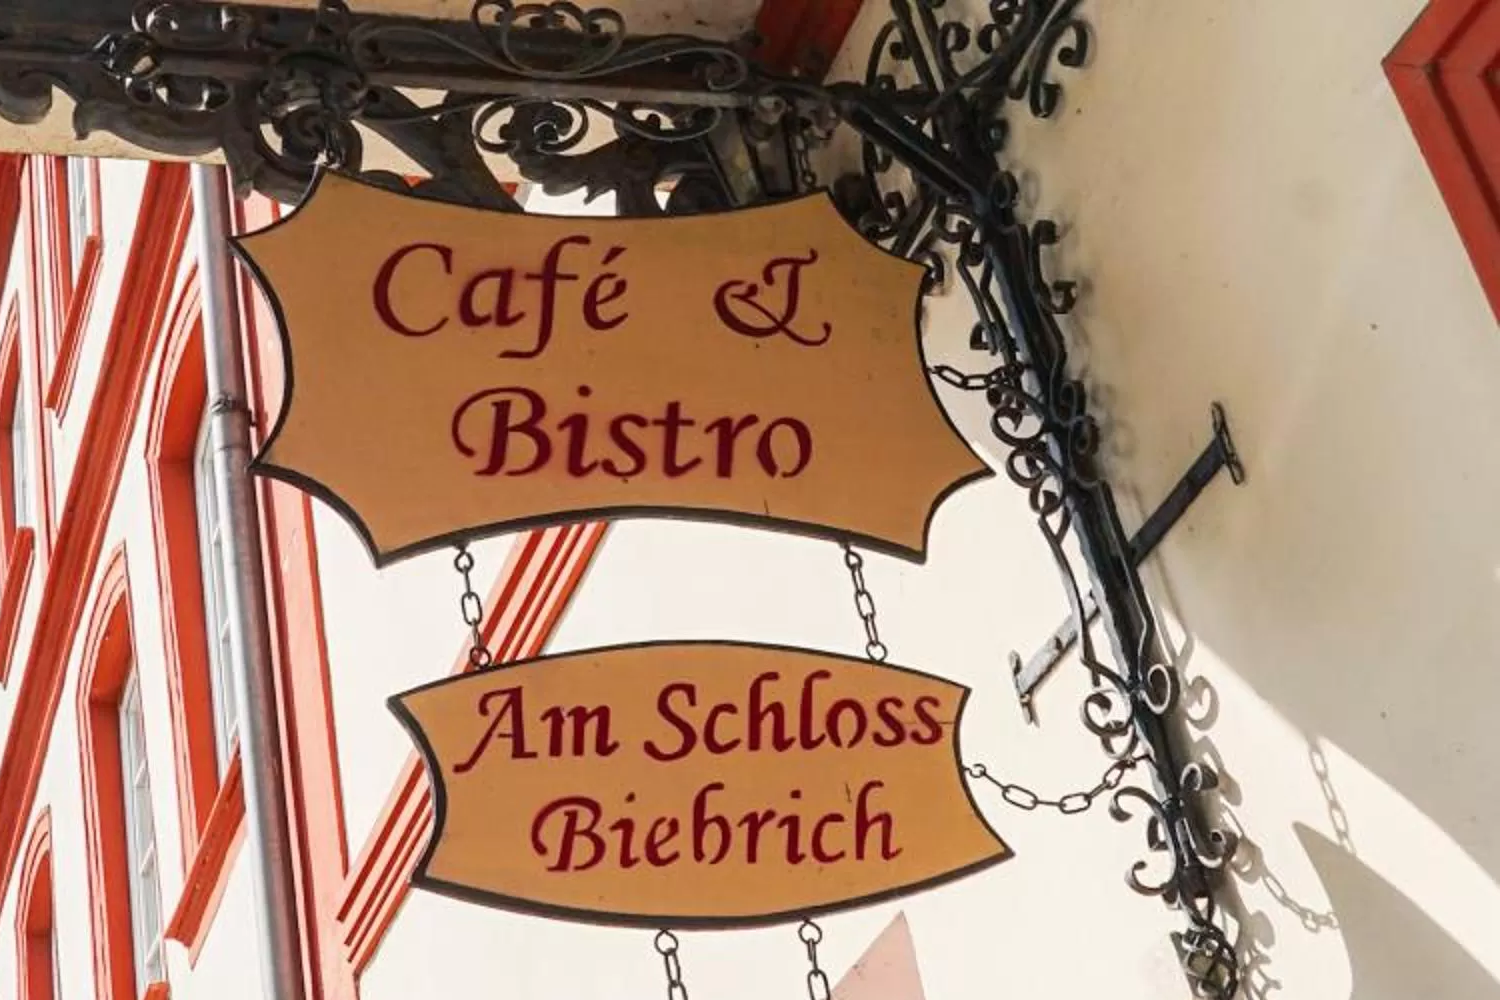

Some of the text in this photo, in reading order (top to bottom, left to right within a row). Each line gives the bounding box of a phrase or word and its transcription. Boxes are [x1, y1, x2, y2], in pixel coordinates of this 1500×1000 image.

[372, 234, 630, 360] Café
[450, 384, 813, 483] Bistro
[453, 669, 944, 774] Am Schloss
[530, 780, 902, 873] Biebrich
